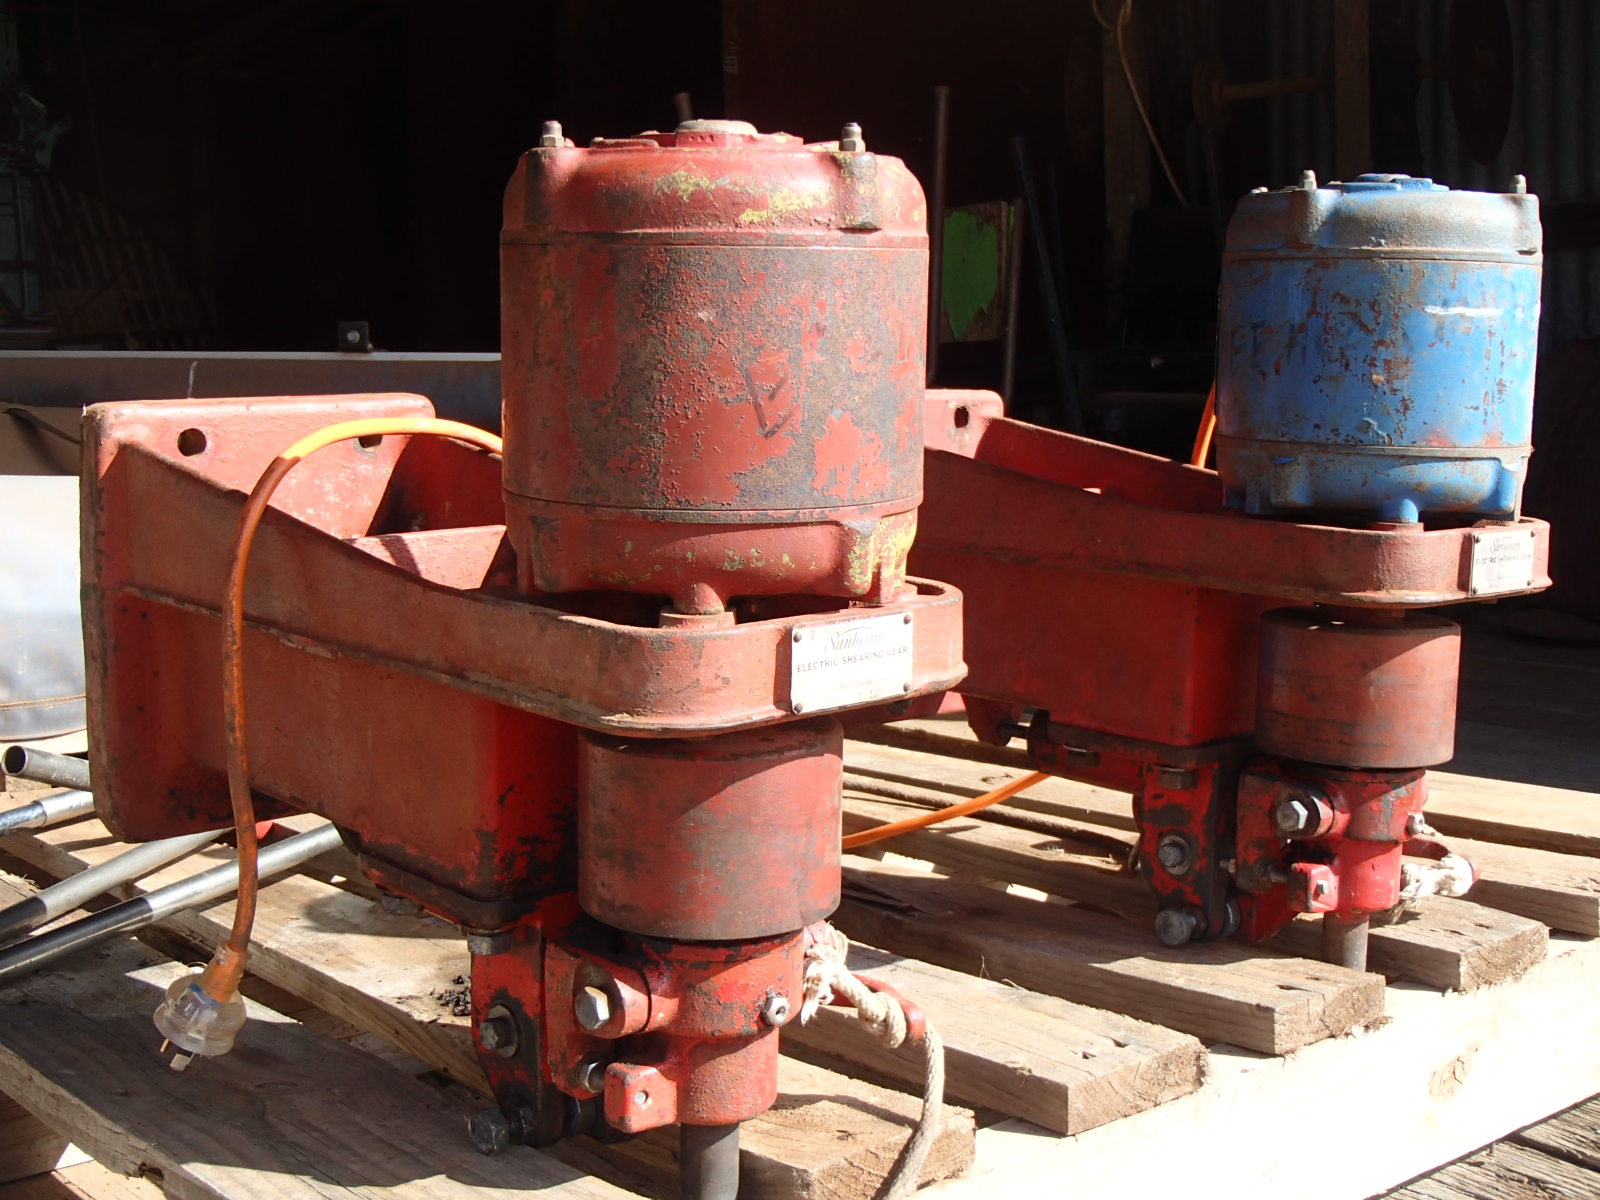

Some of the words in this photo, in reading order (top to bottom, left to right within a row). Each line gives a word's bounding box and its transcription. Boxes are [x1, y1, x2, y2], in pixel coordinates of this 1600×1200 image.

[796, 657, 839, 673] ELECTRIC
[841, 650, 884, 665] SHEARING
[886, 645, 908, 657] GEAR
